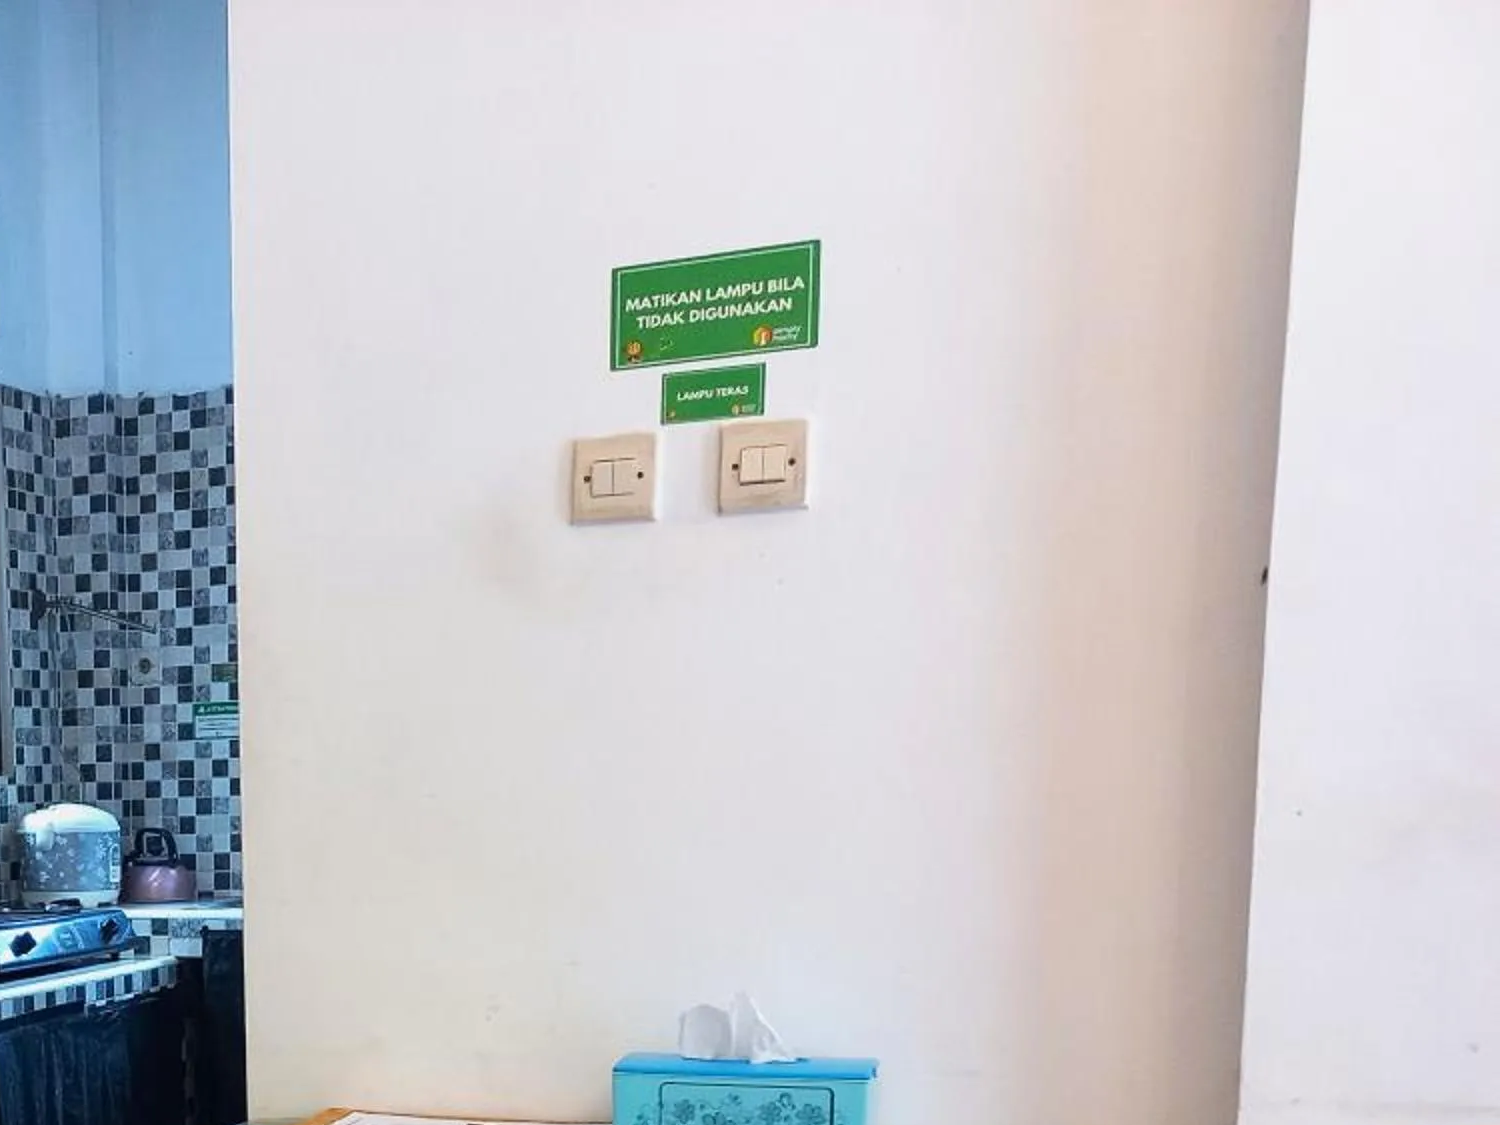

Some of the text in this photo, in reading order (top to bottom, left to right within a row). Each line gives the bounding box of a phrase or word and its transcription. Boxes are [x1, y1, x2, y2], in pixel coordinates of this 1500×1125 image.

[625, 275, 805, 312] MATIKAN LAMPU BILA
[636, 297, 793, 329] TIDAK DIGUNAKAN
[677, 385, 749, 401] LAMPU TERAS
